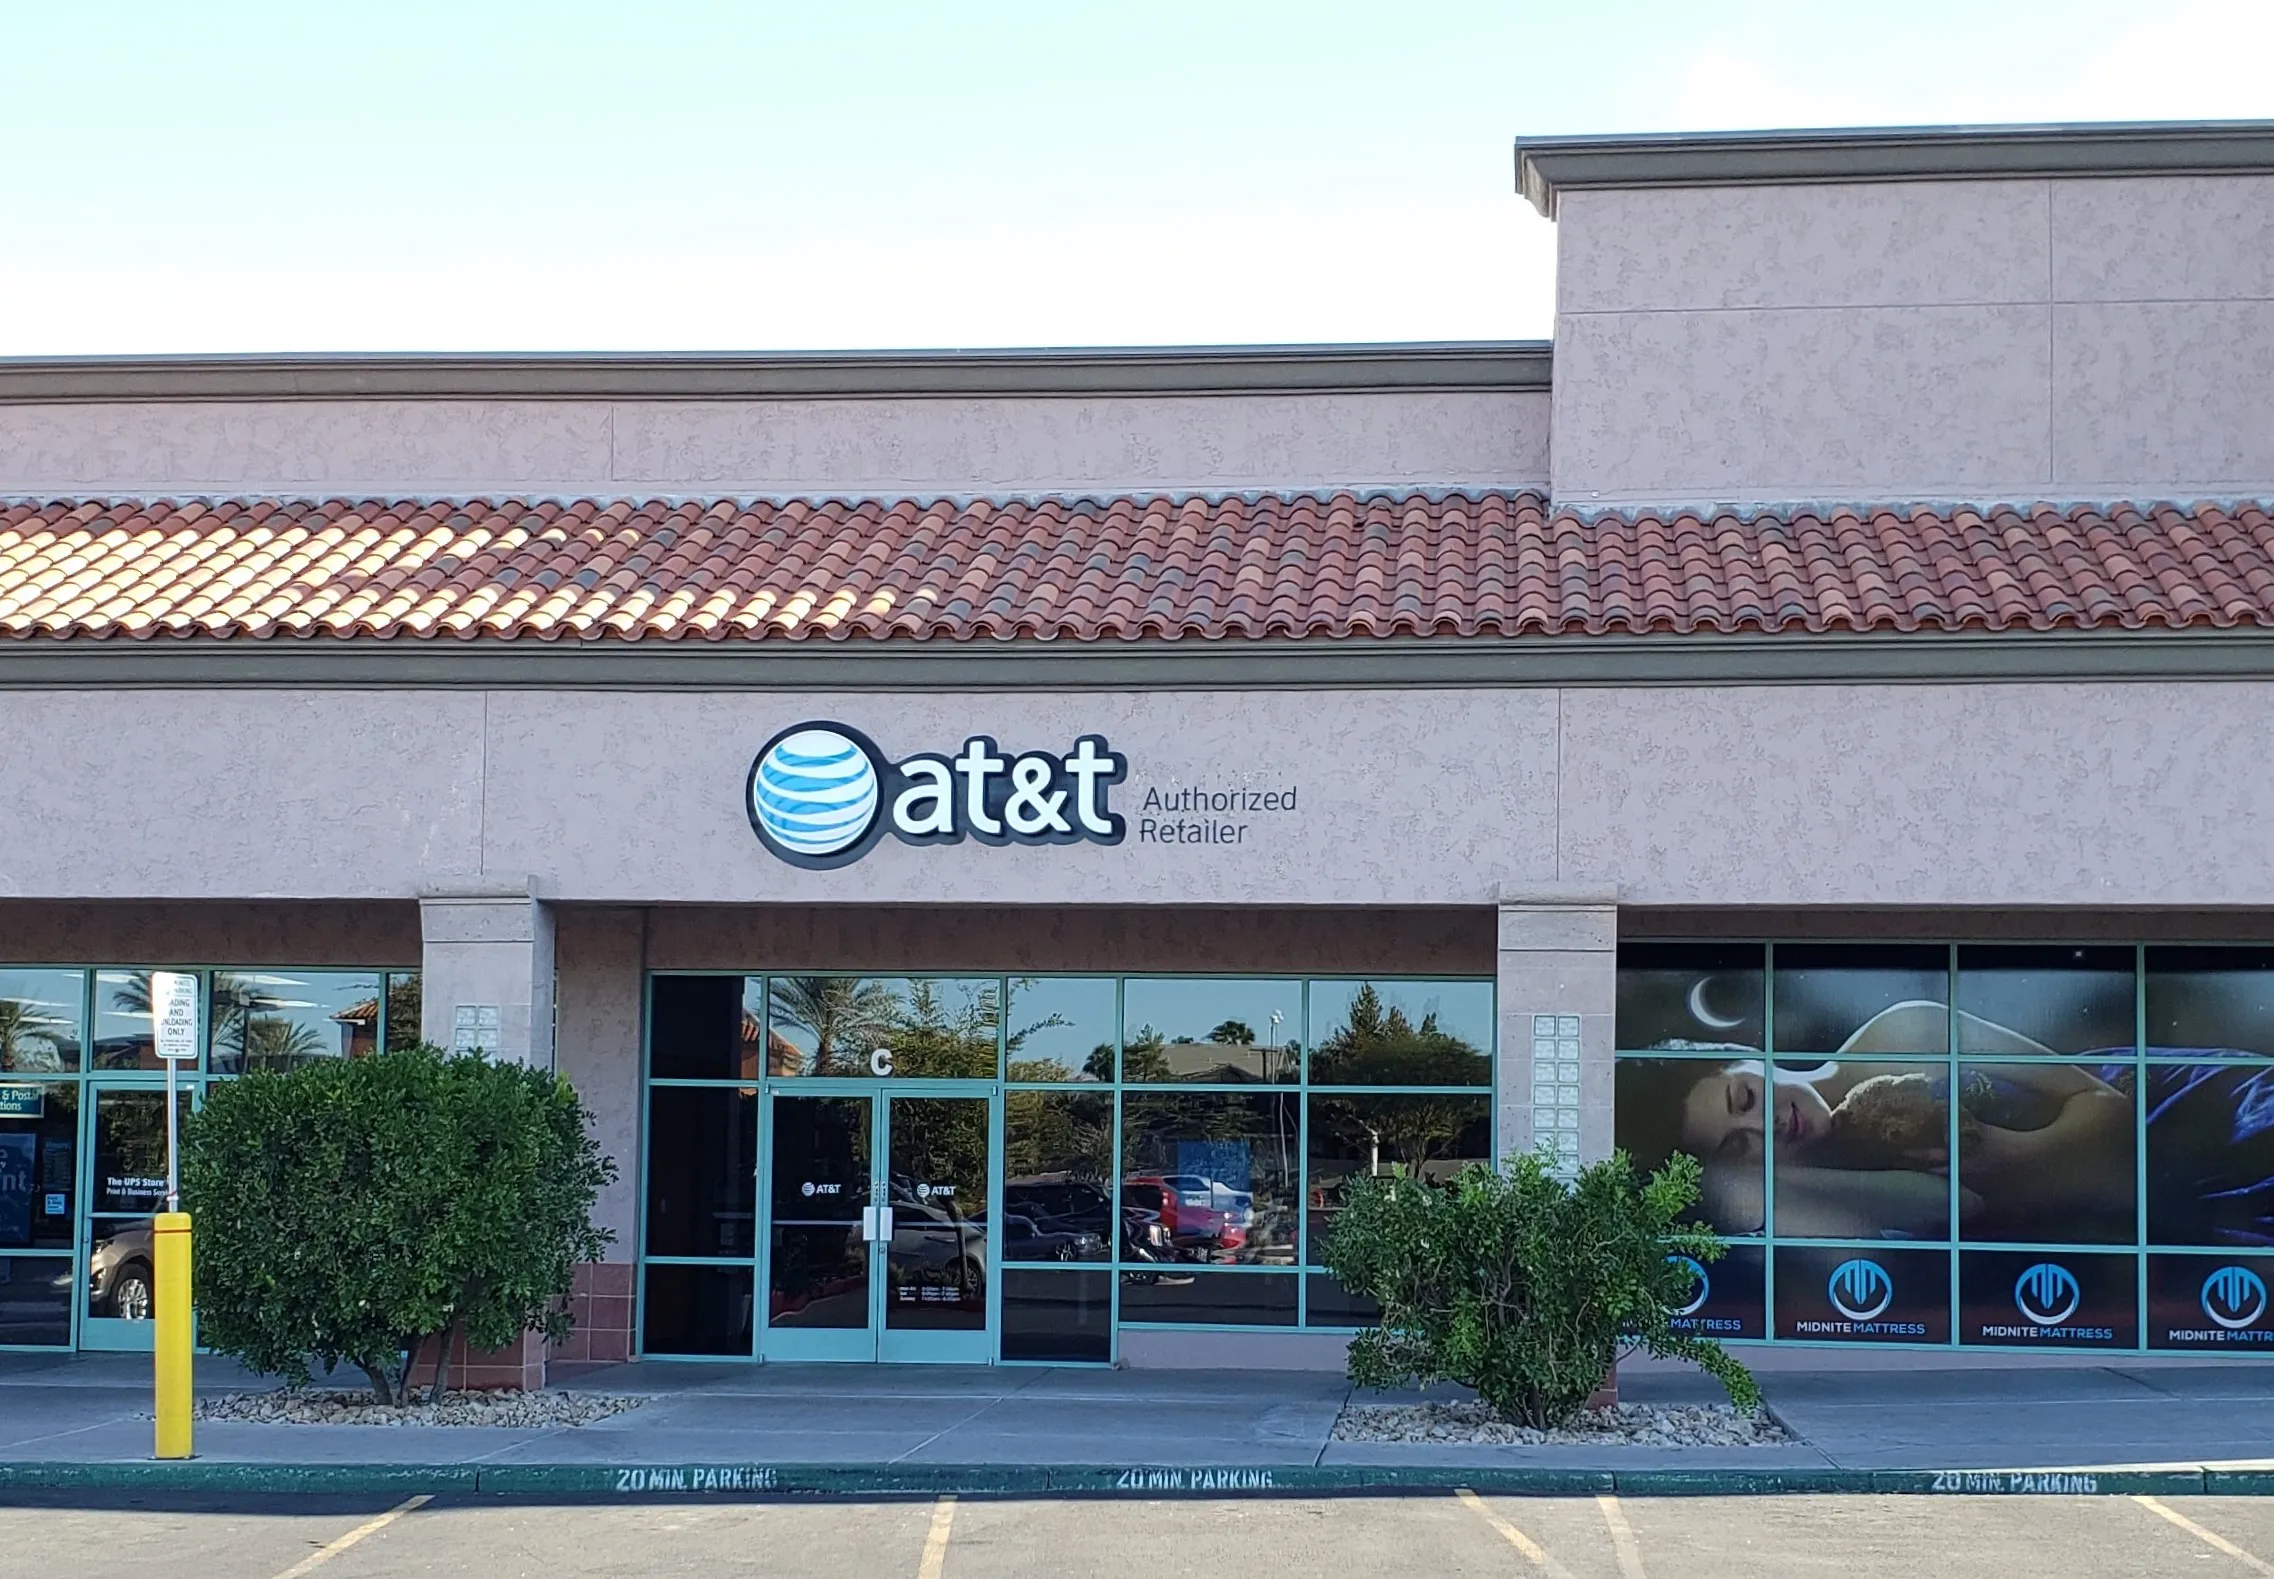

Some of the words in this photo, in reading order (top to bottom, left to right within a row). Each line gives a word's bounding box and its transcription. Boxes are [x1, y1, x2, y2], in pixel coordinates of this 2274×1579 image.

[893, 741, 1113, 834] at&t
[1143, 786, 1297, 811] Authorized
[1140, 819, 1248, 844] Retailer
[169, 1008, 184, 1016] AND
[167, 1028, 185, 1036] ONLY
[871, 1049, 892, 1075] C
[2, 1090, 10, 1100] &
[12, 1090, 38, 1101] Postal
[107, 1177, 122, 1186] The
[124, 1177, 140, 1186] UPS
[142, 1178, 164, 1187] Store
[816, 1184, 841, 1194] AT&T
[127, 1188, 152, 1196] Business
[931, 1186, 956, 1196] AT&T
[1797, 1321, 1852, 1334] MIDNITE
[1853, 1322, 1926, 1335] MATTRESS
[1982, 1325, 2038, 1338] MIDNITE
[2039, 1327, 2113, 1340] MATTRESS
[2169, 1329, 2225, 1342] MIDNITE
[616, 1468, 645, 1491] 20
[692, 1467, 778, 1490] PARKING
[1116, 1468, 1144, 1489] 20
[1190, 1468, 1273, 1490] PARKING
[1932, 1471, 1961, 1491] 20
[2010, 1472, 2098, 1494] PARKING
